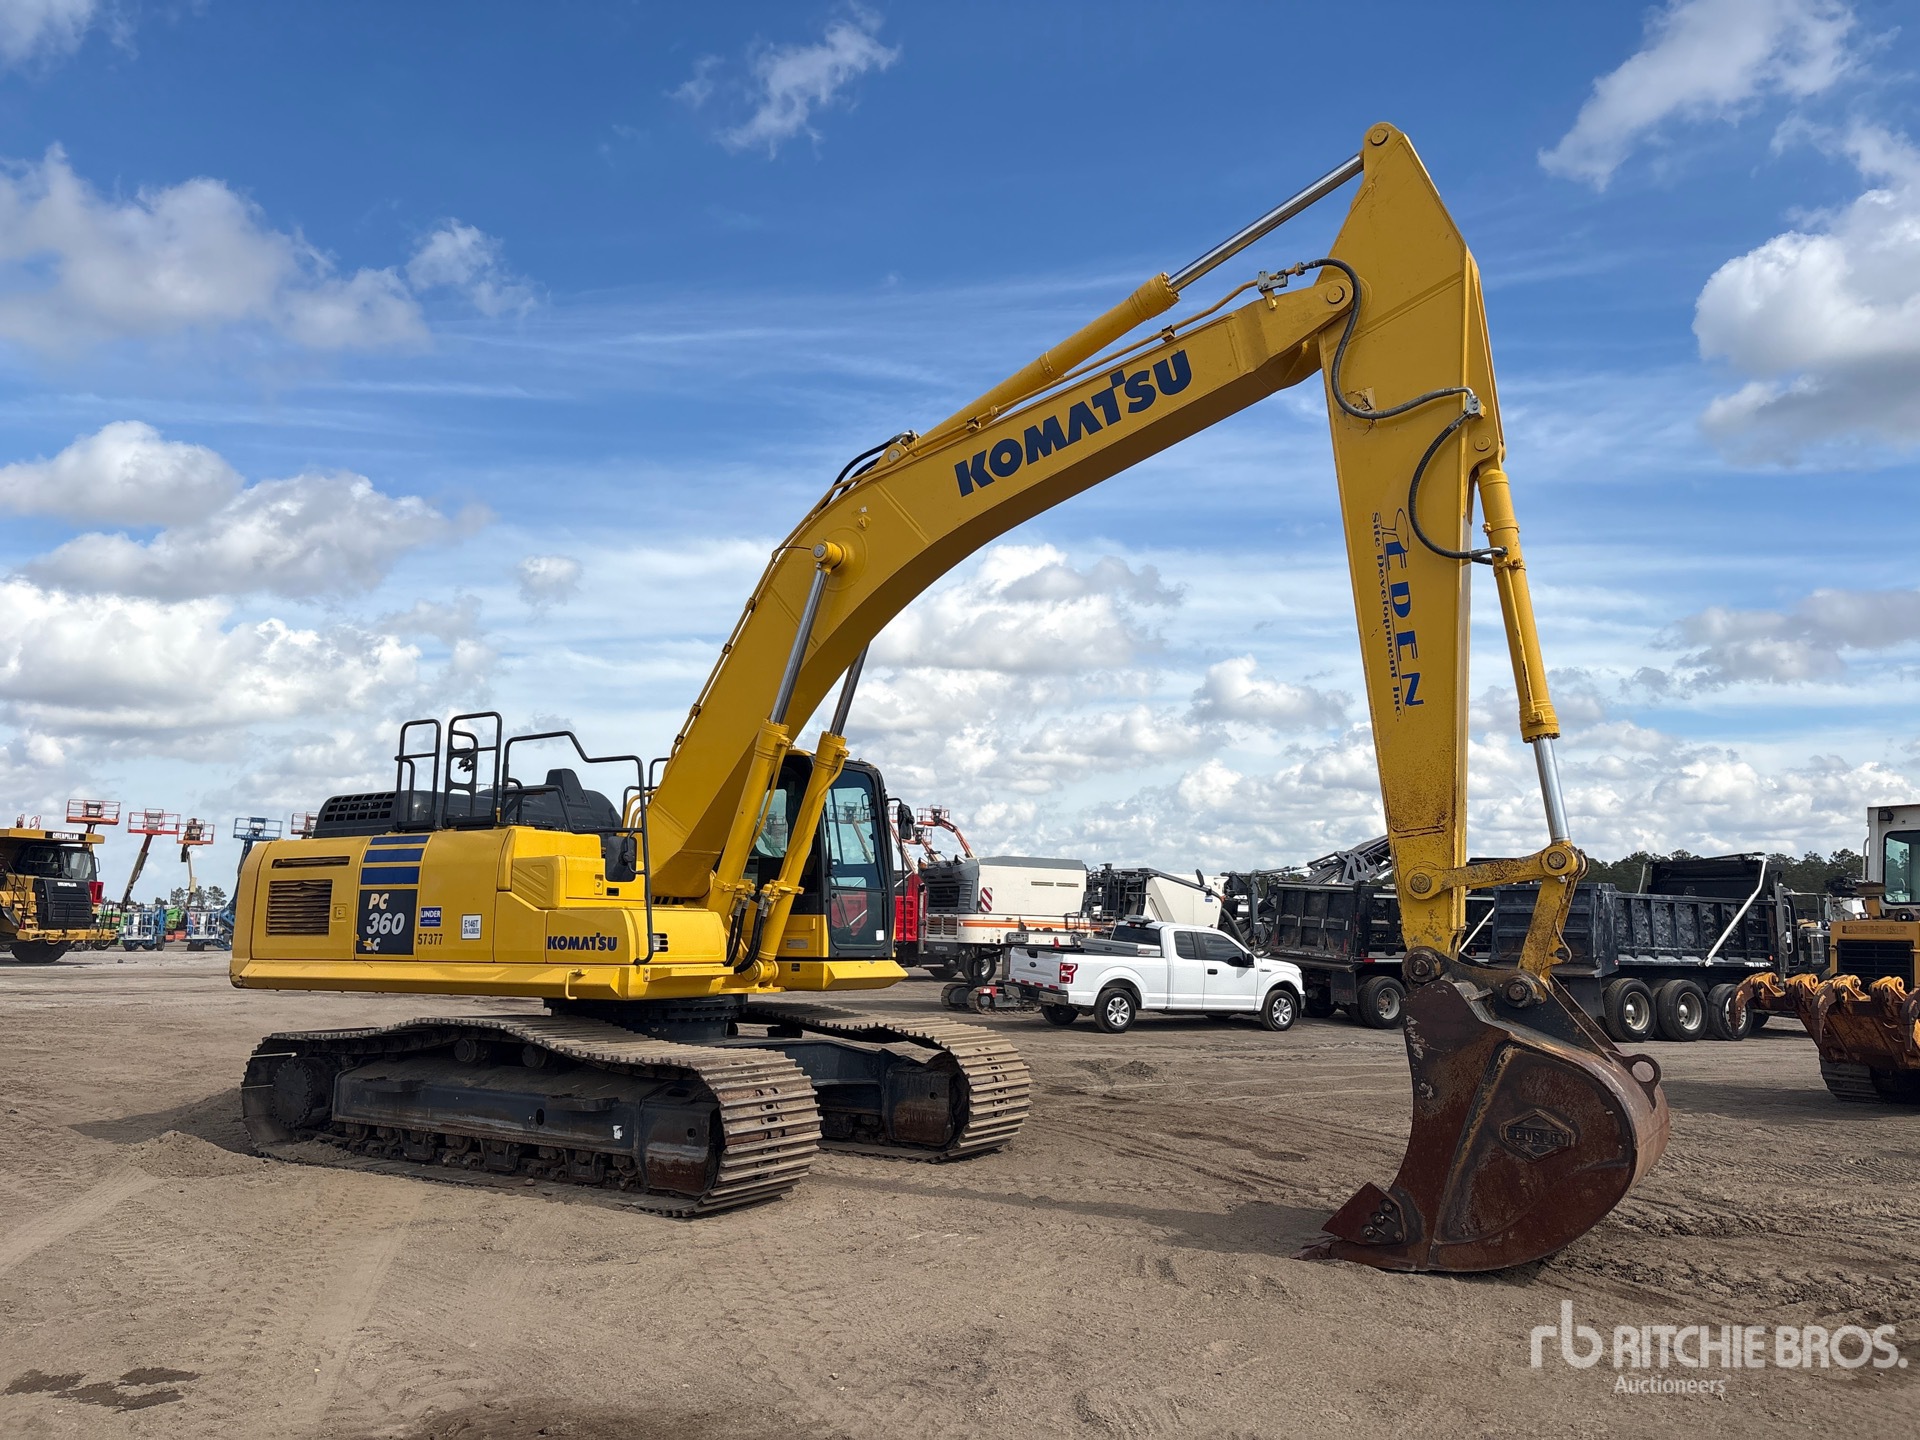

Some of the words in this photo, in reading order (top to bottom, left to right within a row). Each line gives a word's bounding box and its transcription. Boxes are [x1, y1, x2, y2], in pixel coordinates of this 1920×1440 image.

[954, 349, 1193, 497] KOMATSU
[1372, 512, 1381, 547] Site
[1376, 554, 1398, 678] Development
[1385, 541, 1425, 706] EDEN
[368, 893, 390, 910] PC
[366, 912, 406, 935] 360
[421, 910, 441, 918] LINDER
[418, 933, 444, 946] 57377
[547, 932, 618, 952] KOMATSU
